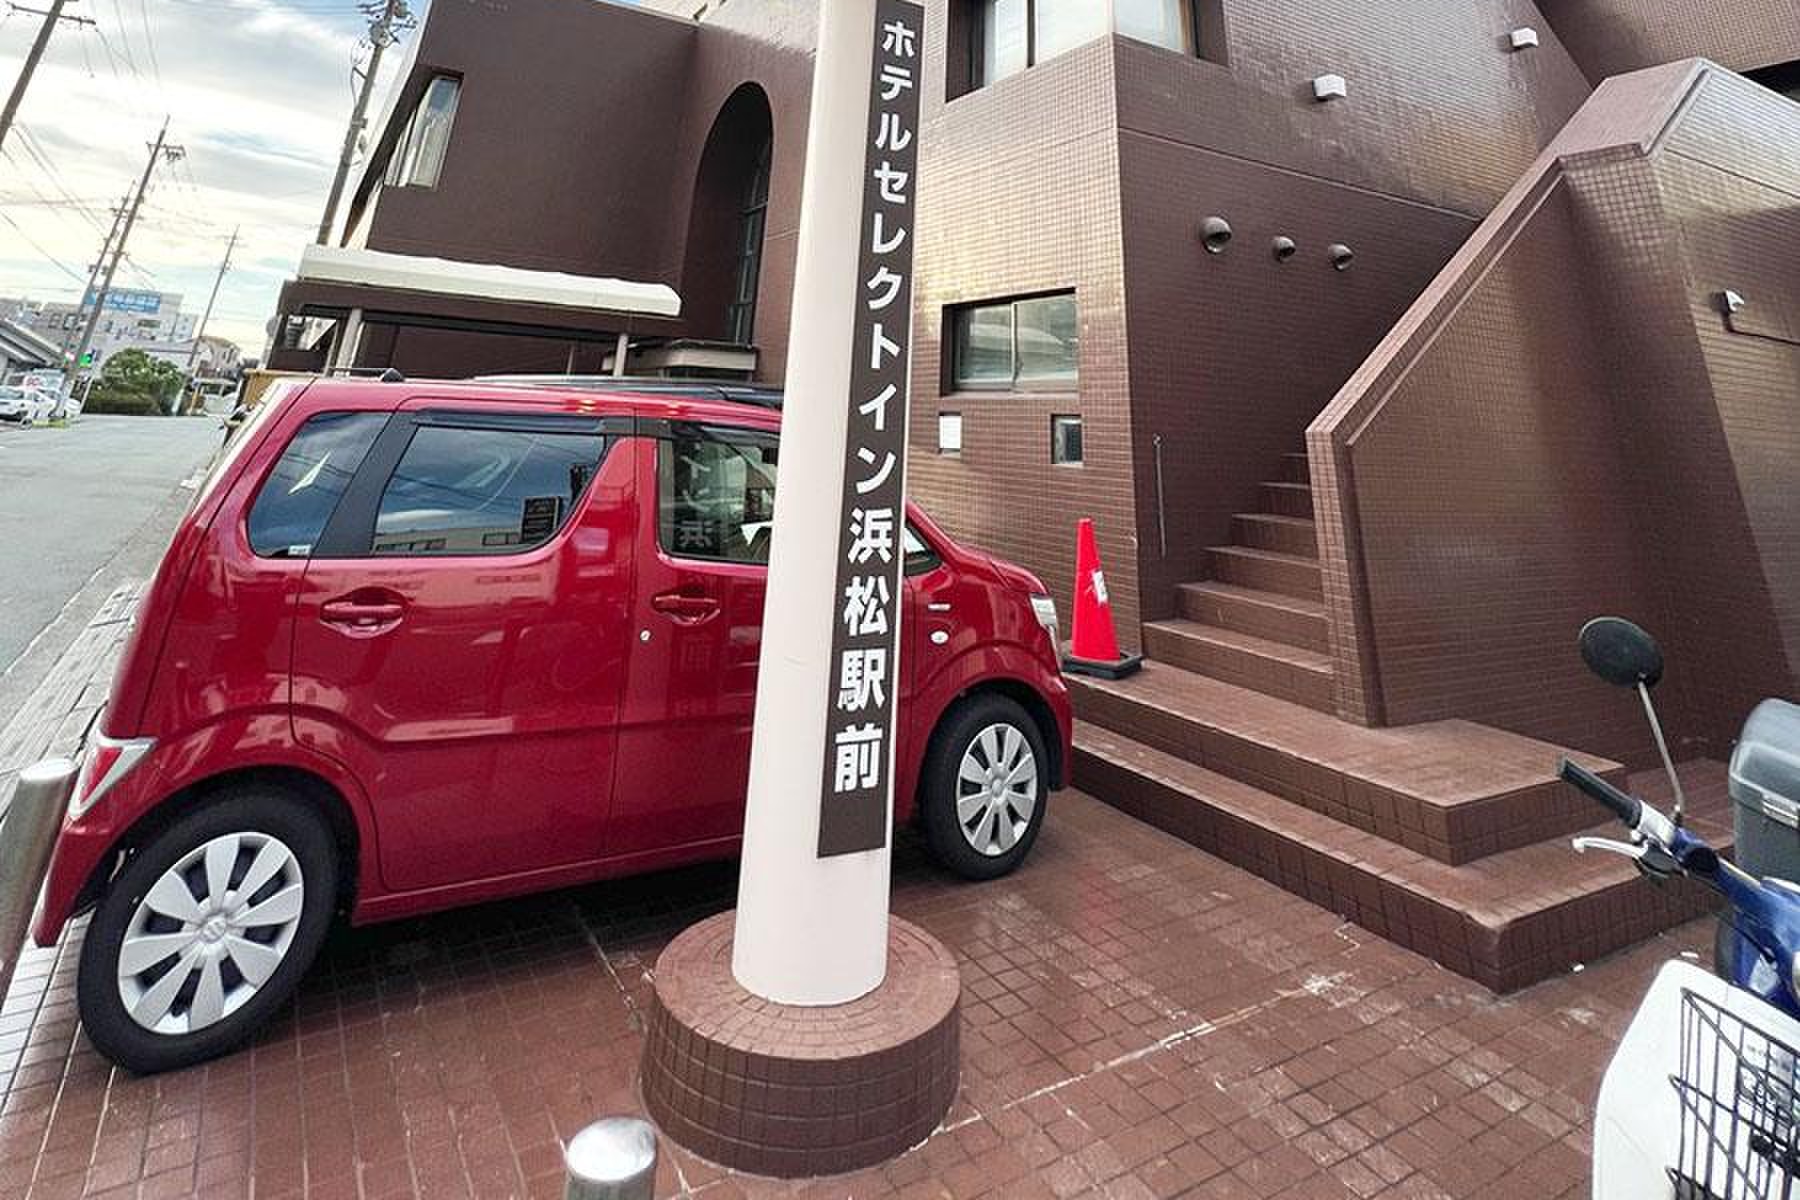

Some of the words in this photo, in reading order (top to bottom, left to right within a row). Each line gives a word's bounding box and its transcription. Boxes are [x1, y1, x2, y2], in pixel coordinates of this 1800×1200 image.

[834, 19, 917, 793] ホテルセレクトイン浜松駅前
